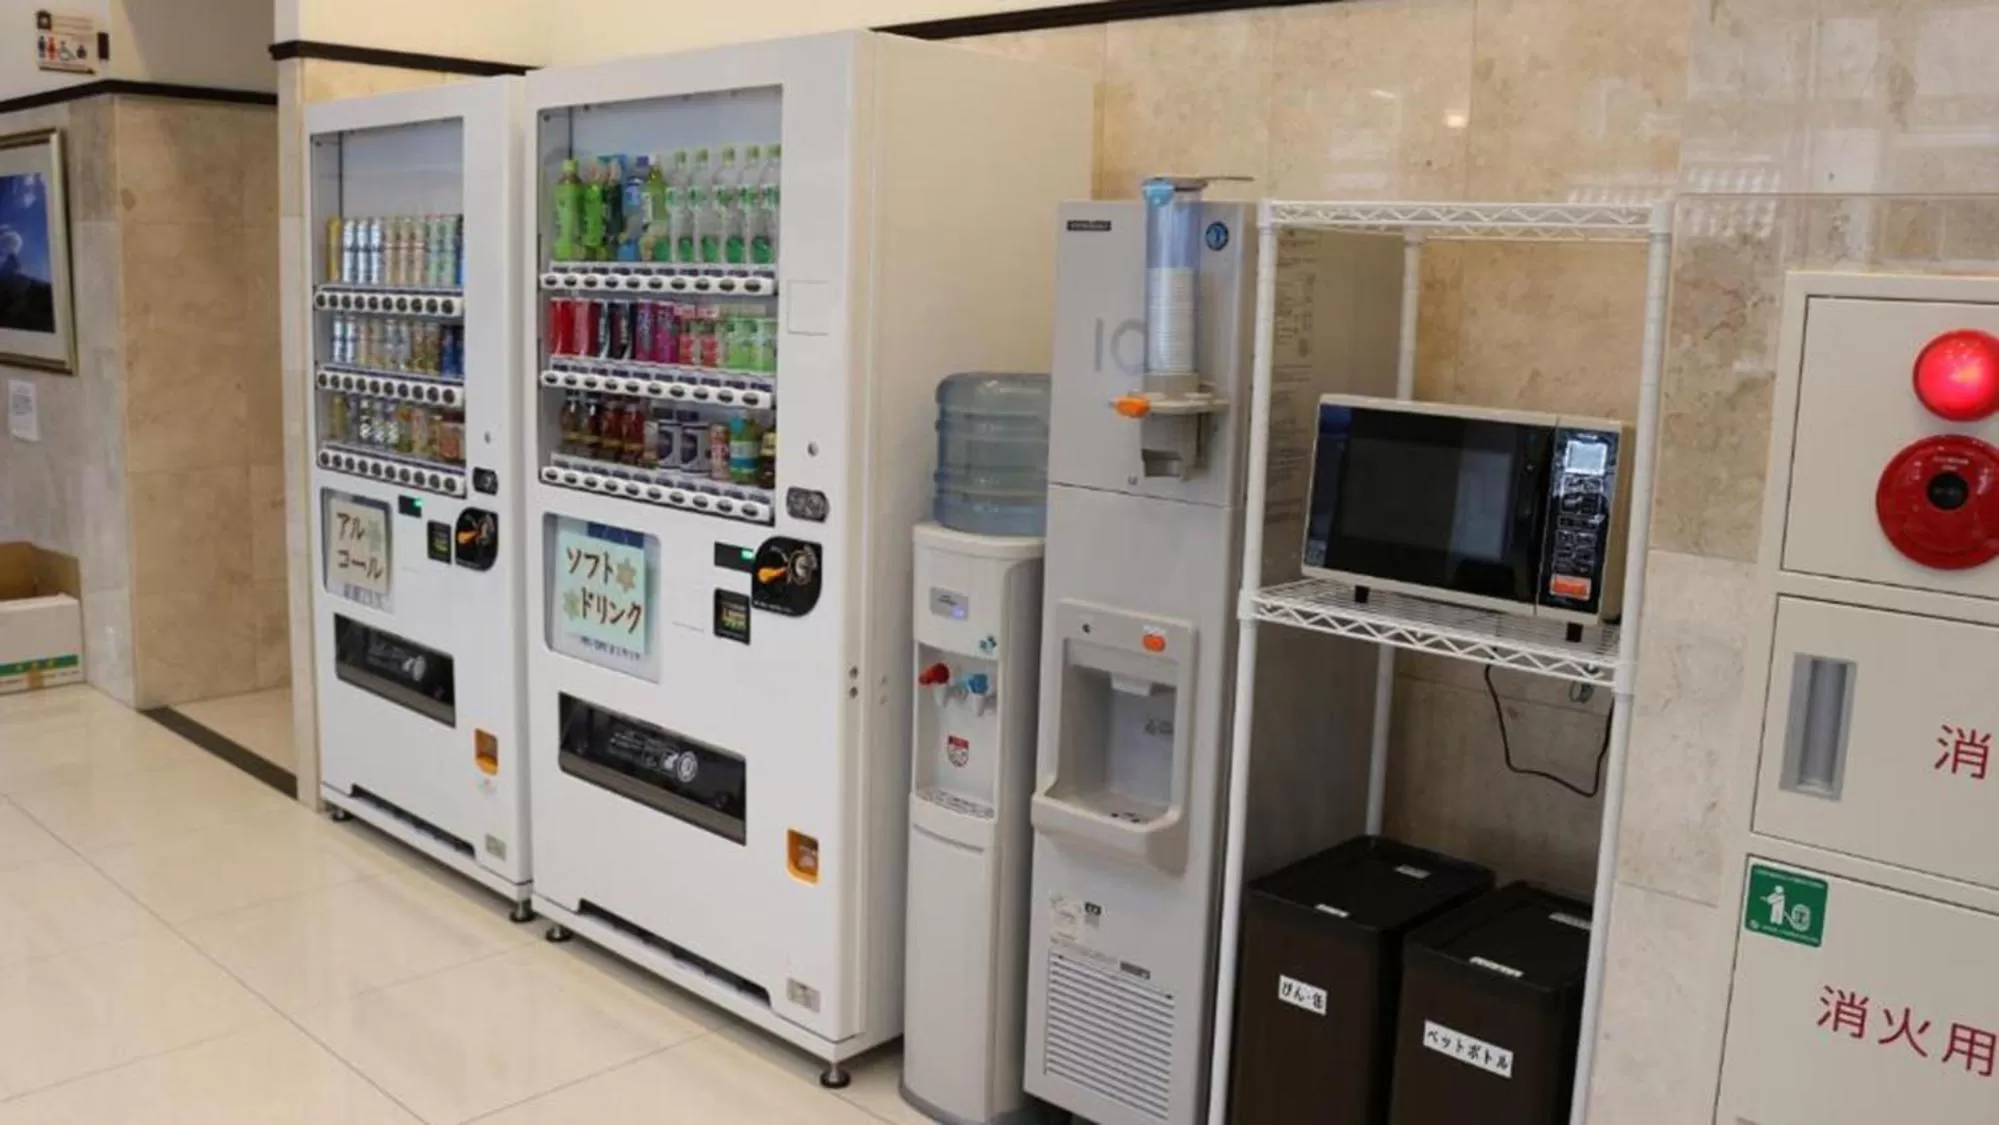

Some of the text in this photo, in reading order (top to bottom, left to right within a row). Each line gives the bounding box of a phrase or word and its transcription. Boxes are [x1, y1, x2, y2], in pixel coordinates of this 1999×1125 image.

[336, 511, 365, 540] アル
[336, 549, 383, 580] コール
[567, 547, 614, 584] ソフト
[581, 586, 642, 635] ドリンク
[1934, 724, 1992, 780] 消
[1427, 1029, 1509, 1070] ペットボトル
[1816, 984, 1998, 1077] 消火用
